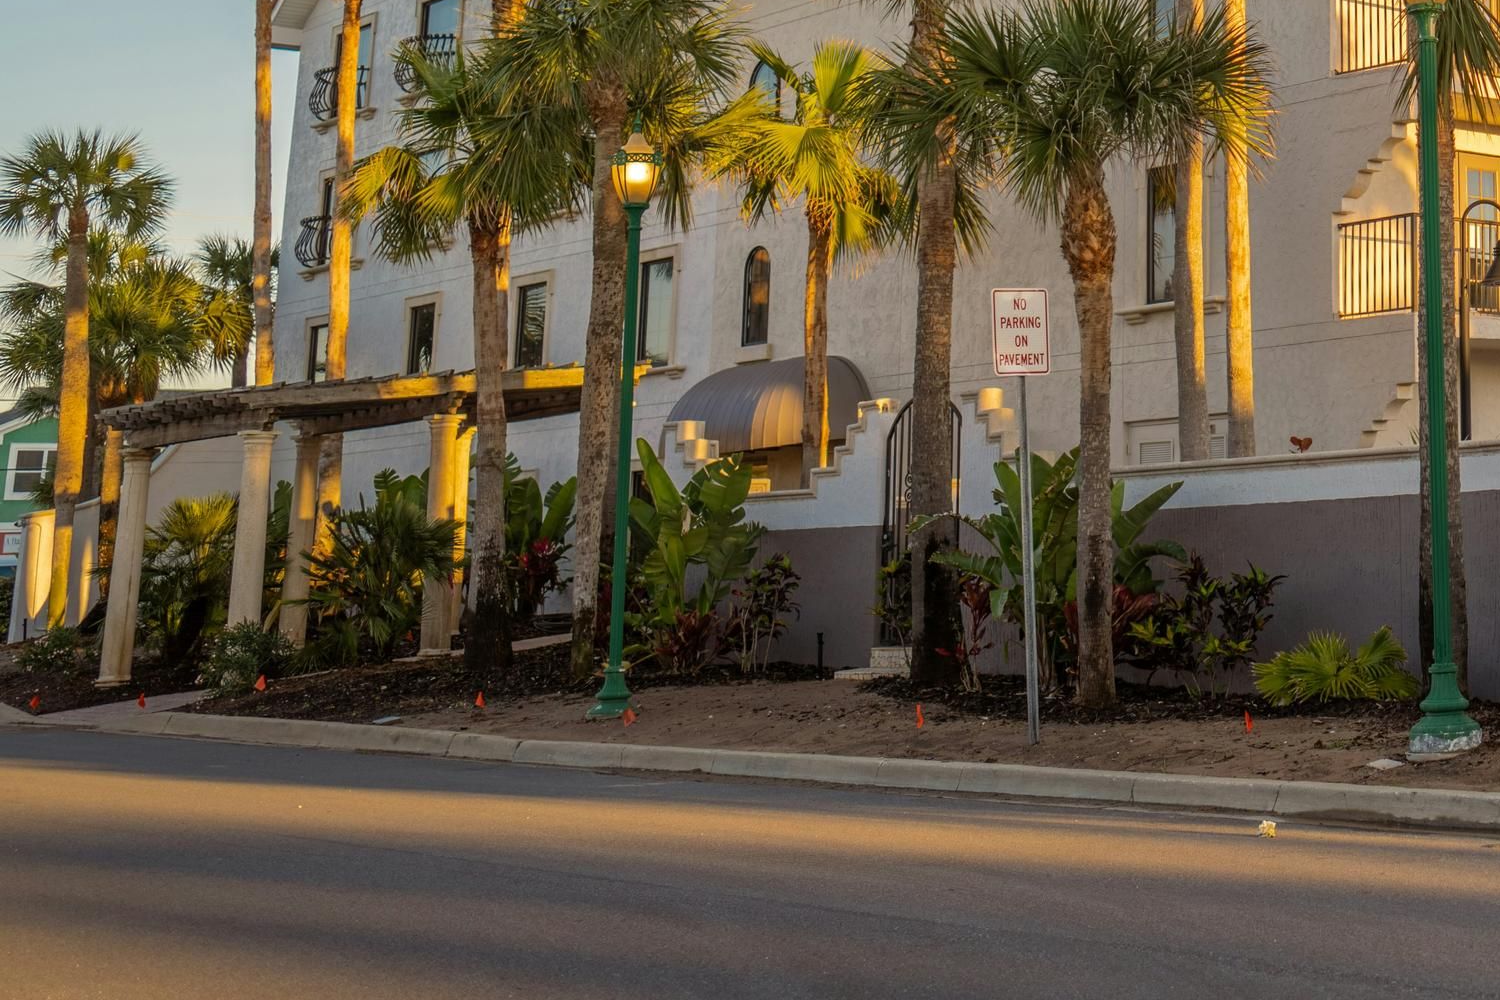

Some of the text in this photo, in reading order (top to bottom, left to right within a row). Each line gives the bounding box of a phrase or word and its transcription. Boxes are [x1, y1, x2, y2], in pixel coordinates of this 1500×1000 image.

[1013, 298, 1027, 310] NO
[1000, 316, 1041, 328] PARKING
[1014, 335, 1028, 347] ON
[999, 353, 1044, 366] PAVEMENT
